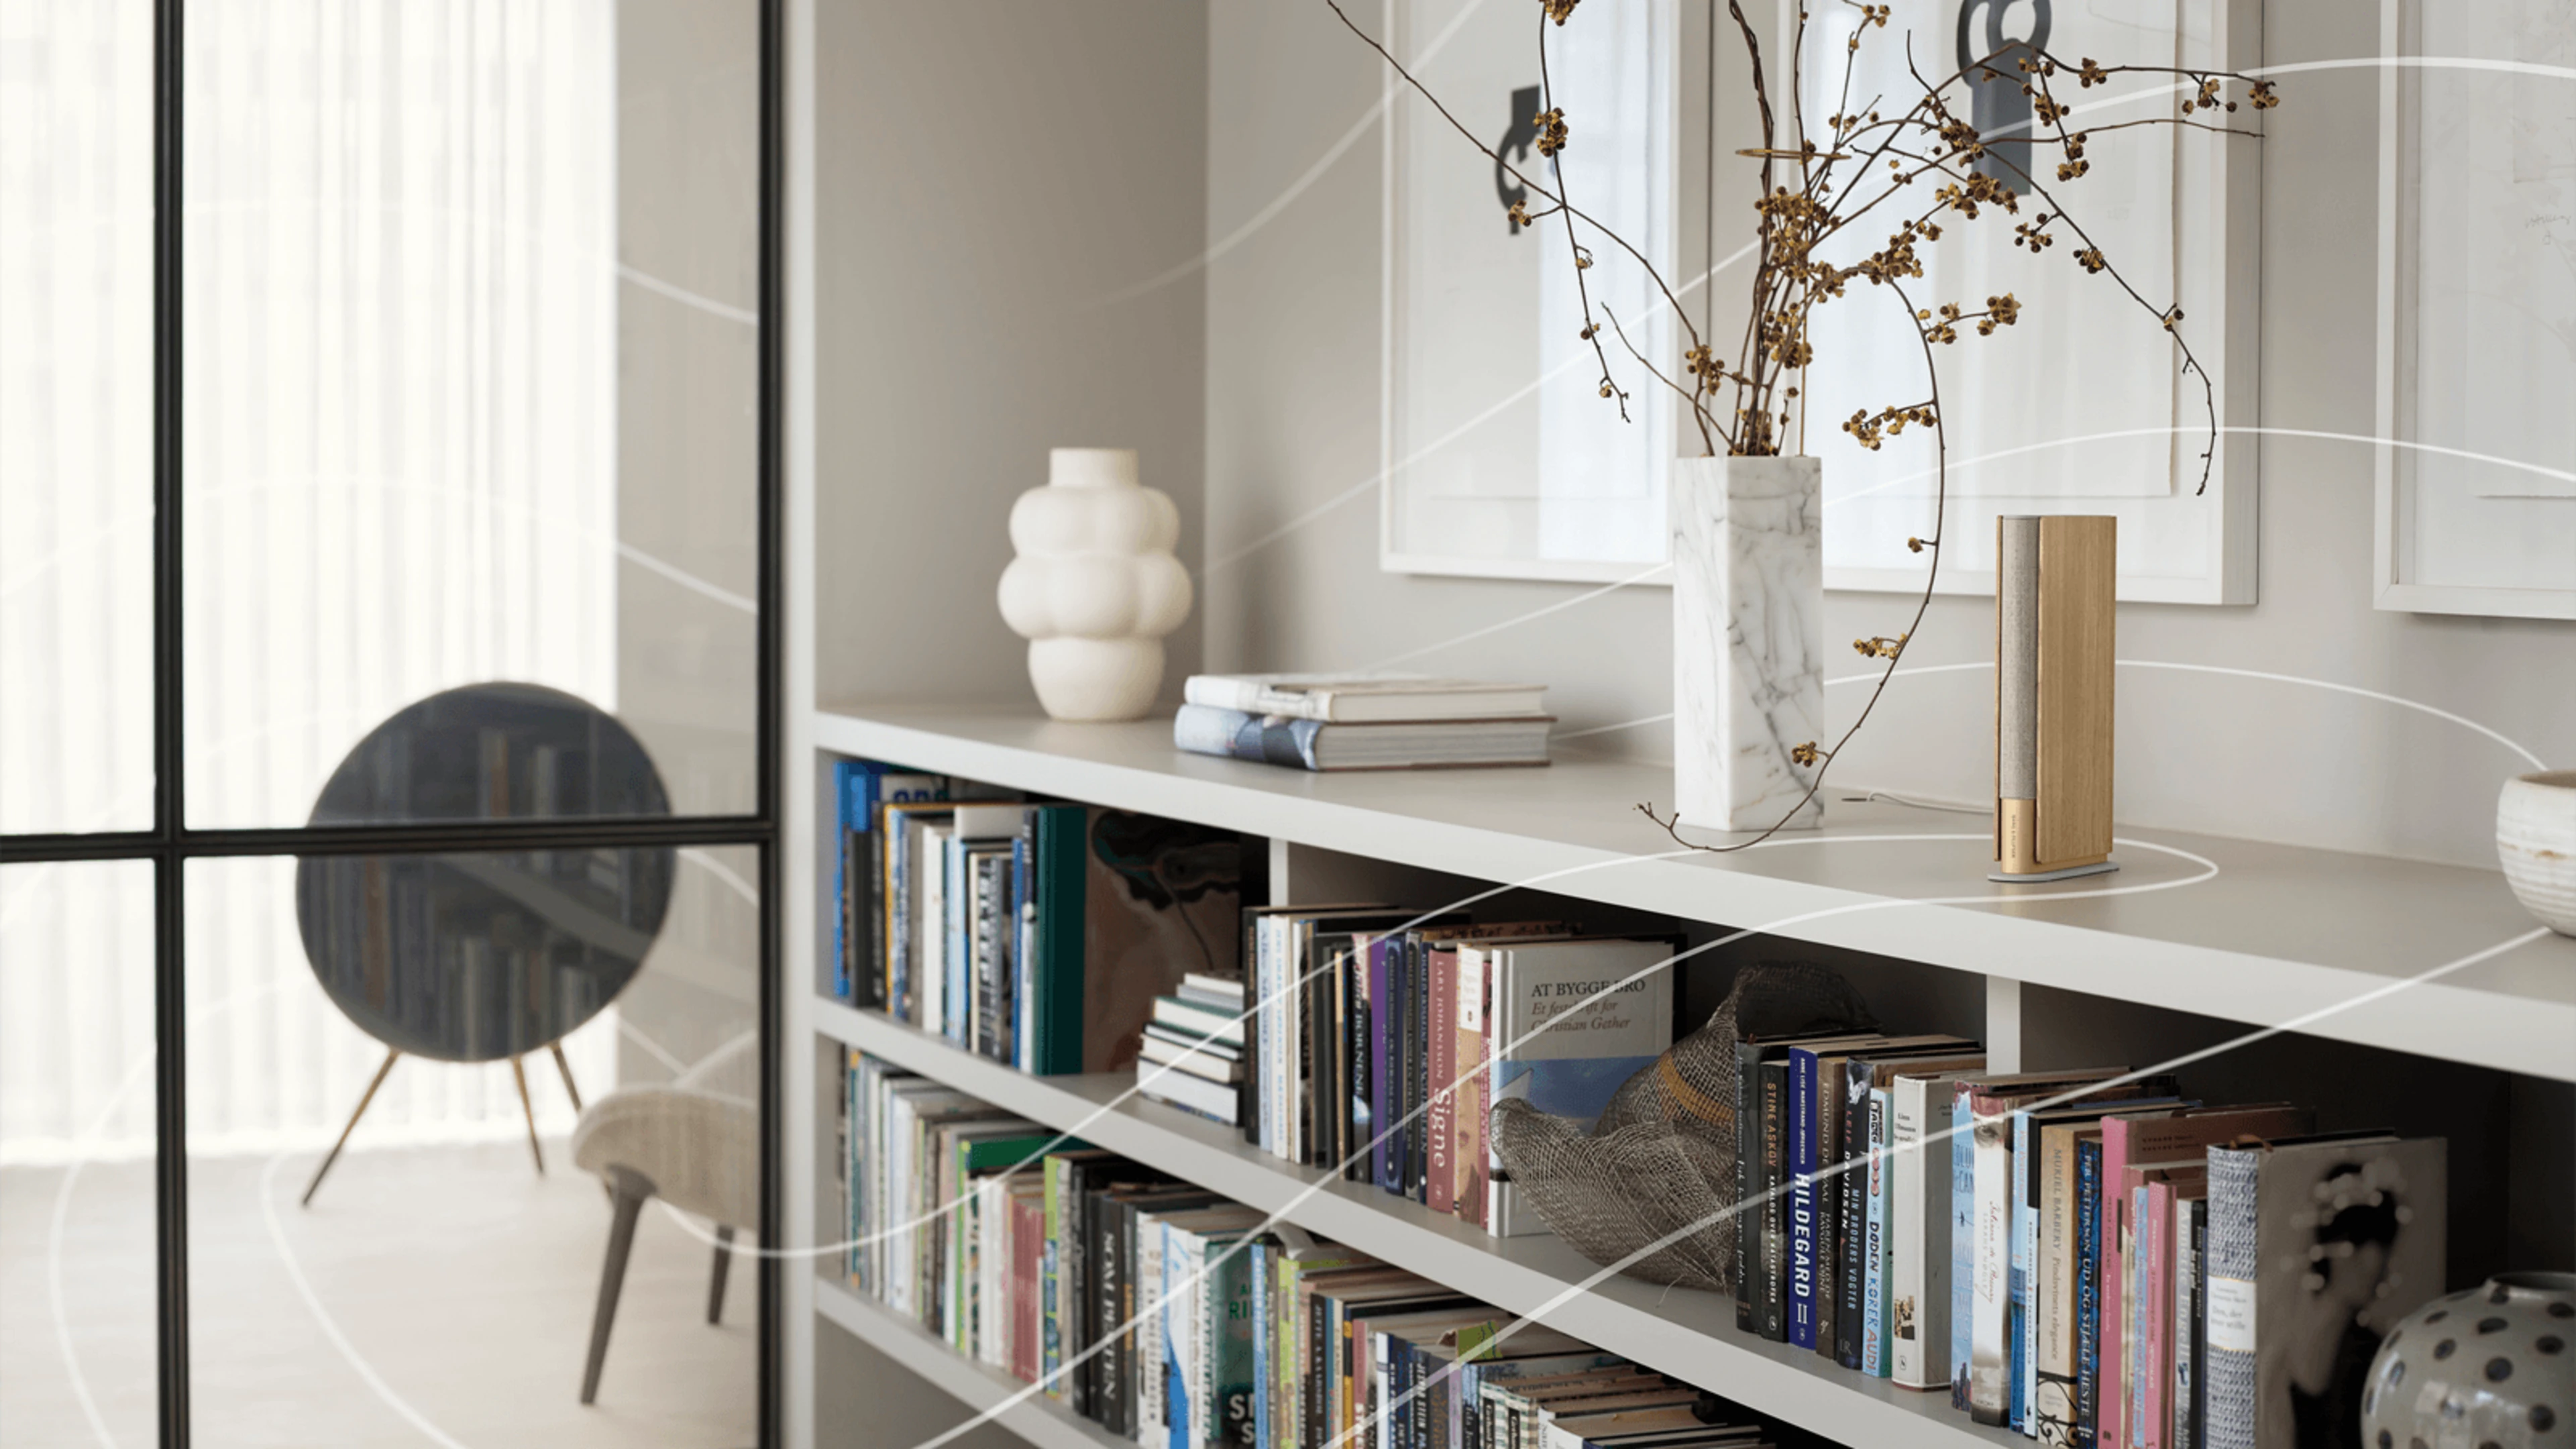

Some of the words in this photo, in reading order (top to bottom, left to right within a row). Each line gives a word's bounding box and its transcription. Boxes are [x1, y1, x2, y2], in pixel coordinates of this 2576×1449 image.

[1531, 983, 1551, 997] AT
[1556, 981, 1609, 996] BYGGE
[1532, 1002, 1546, 1015] Et
[1591, 1016, 1630, 1030] Gether
[1767, 1082, 1776, 1122] STINE
[1431, 1087, 1451, 1167] Signe
[1767, 1125, 1776, 1167] ASKOV
[1842, 1150, 1851, 1228] DAVIDSEN
[2053, 1148, 2061, 1193] MURIEL
[1851, 1189, 1860, 1208] MIN
[2084, 1181, 2092, 1252] PETTERSON
[1795, 1173, 1810, 1297] HILDEGARD
[2053, 1198, 2061, 1250] BARBERY
[1870, 1222, 1880, 1271] DØDEN
[2180, 1207, 2190, 1285] Annette
[1848, 1269, 1857, 1309] VOGTER
[2083, 1257, 2091, 1281] UD
[1868, 1277, 1878, 1326] KØRER
[2083, 1285, 2091, 1308] OG
[2050, 1317, 2060, 1360] elegance
[2177, 1294, 2190, 1356] Engell
[1866, 1329, 1877, 1369] AUDI
[2081, 1368, 2090, 1416] HESTE
[1417, 1401, 1426, 1428] STEIN
